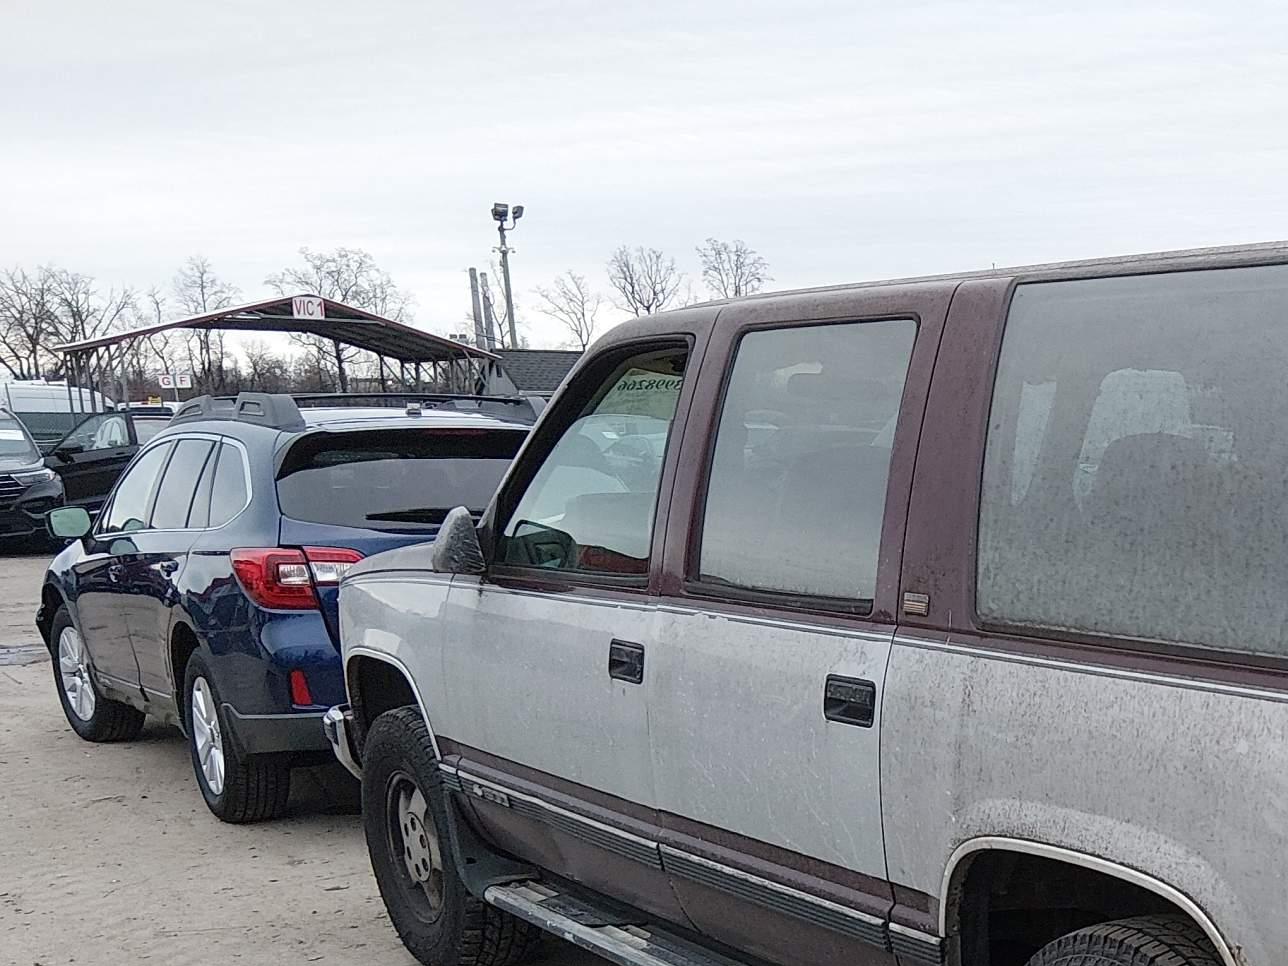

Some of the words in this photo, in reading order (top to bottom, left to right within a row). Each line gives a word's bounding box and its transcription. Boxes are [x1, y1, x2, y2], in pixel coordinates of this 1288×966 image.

[293, 299, 314, 317] VIC
[316, 300, 324, 317] 1
[161, 376, 171, 386] G
[179, 376, 187, 385] F
